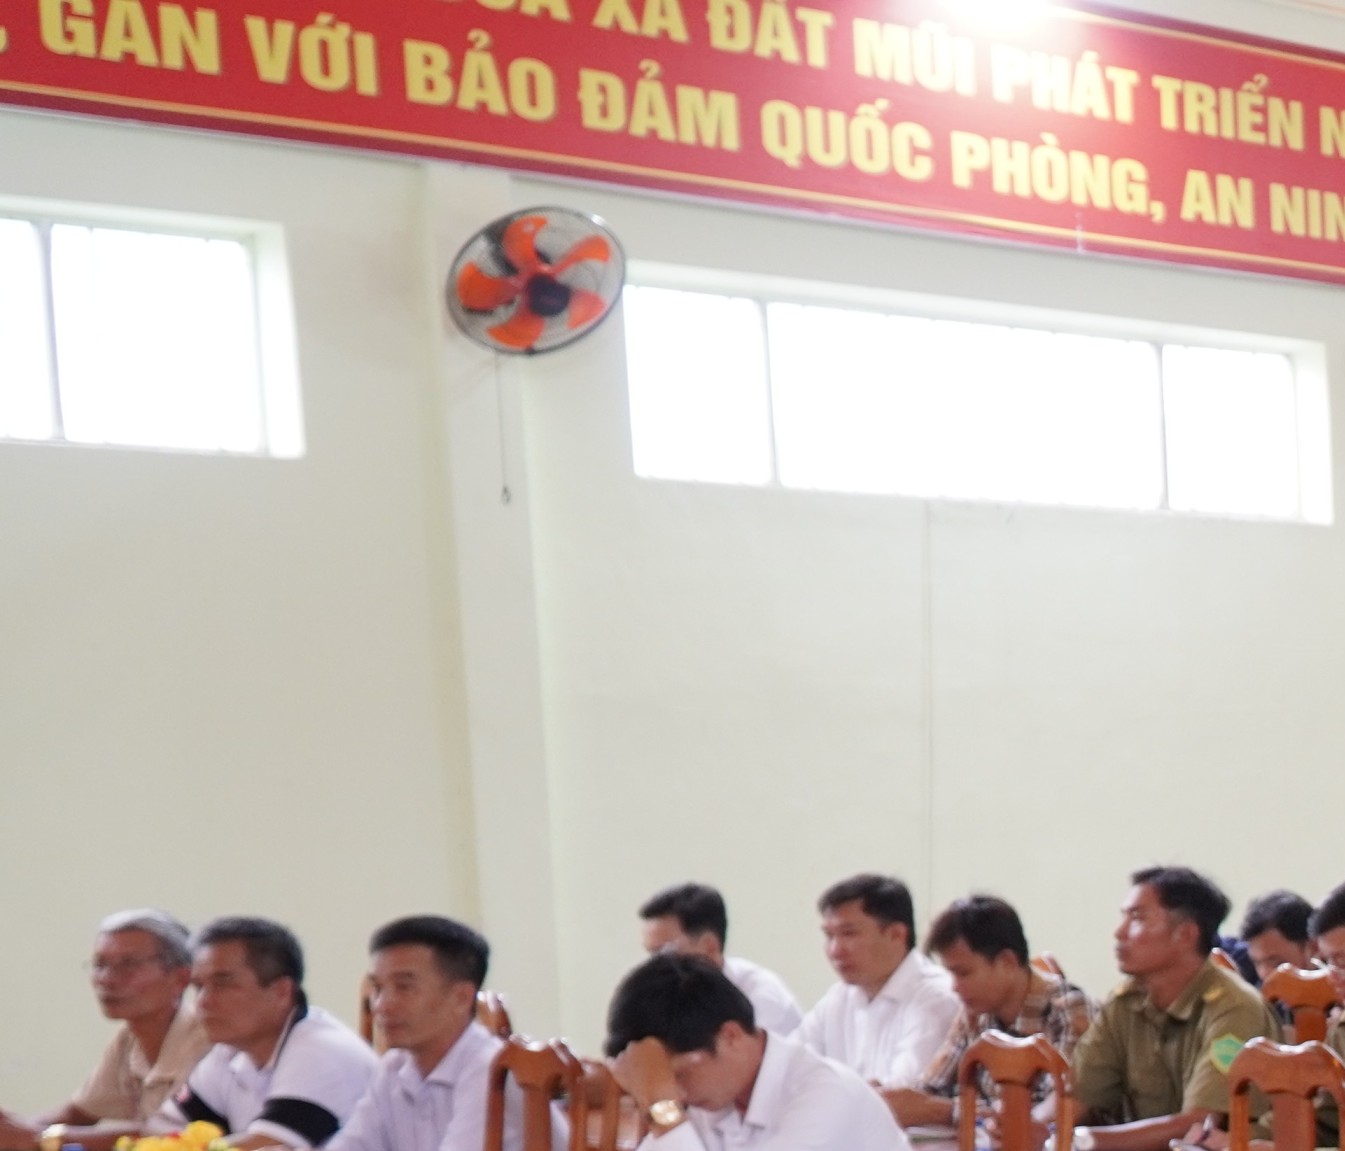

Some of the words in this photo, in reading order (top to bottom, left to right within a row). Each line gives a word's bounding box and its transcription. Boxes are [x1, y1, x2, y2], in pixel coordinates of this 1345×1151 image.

[244, 12, 379, 97] VỚI
[403, 28, 558, 122] BẢO
[578, 59, 741, 152] ĐẢM
[760, 97, 934, 180] QUỐC
[950, 129, 1166, 223] PHÒNG,
[1180, 169, 1256, 229] AN
[990, 43, 1140, 125] PHÁT
[1152, 73, 1304, 152] TRIỂN
